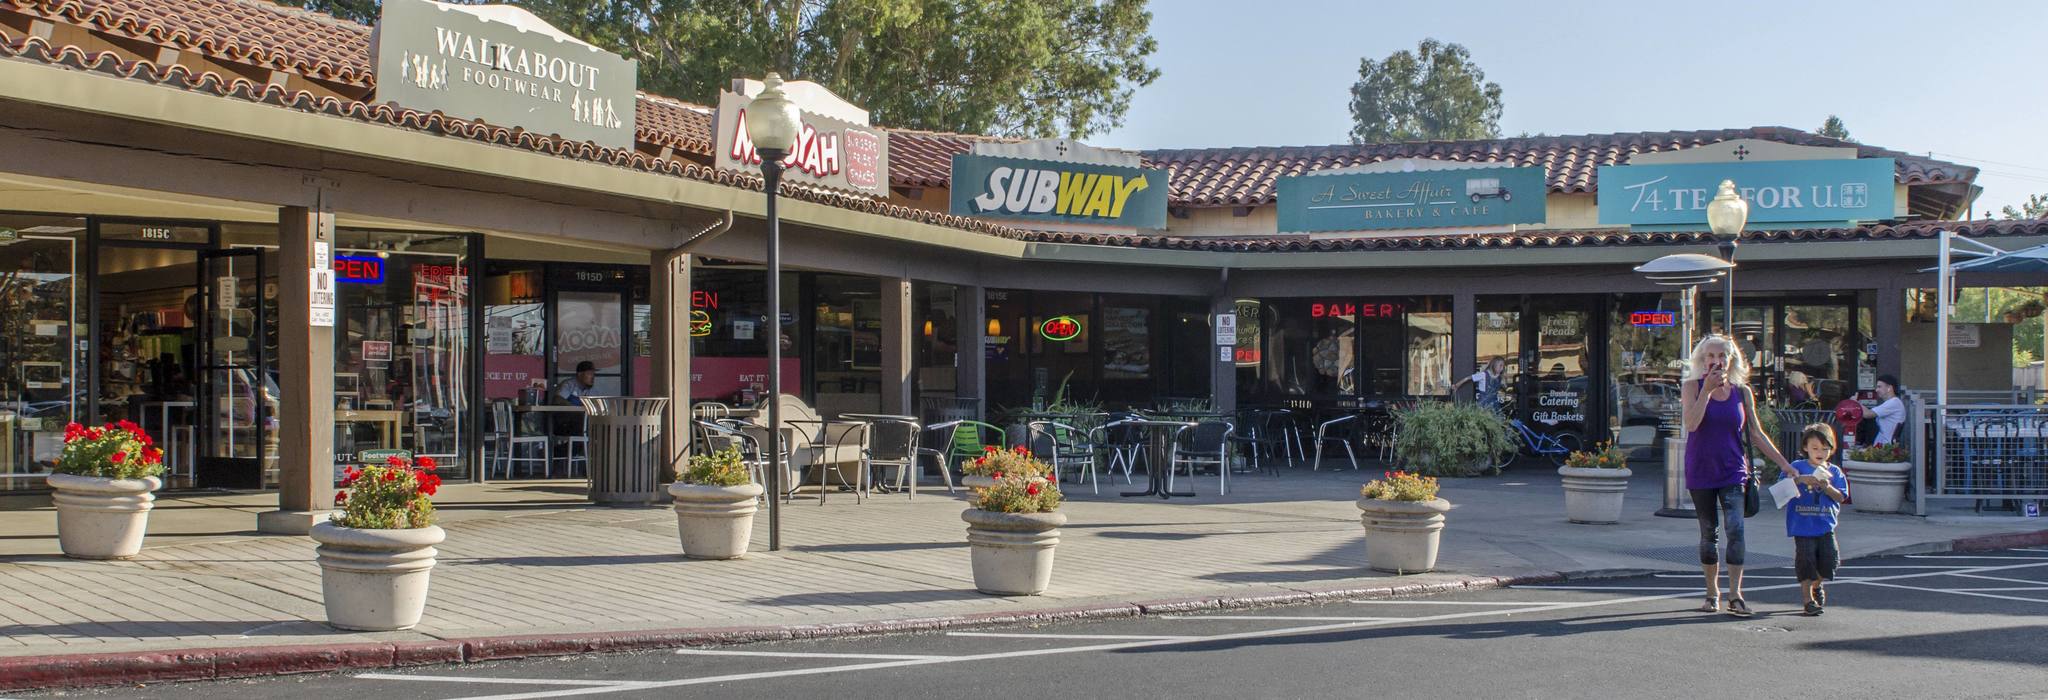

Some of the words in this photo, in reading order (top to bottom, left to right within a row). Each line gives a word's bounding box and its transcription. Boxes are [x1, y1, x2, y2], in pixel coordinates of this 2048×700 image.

[435, 26, 600, 93] WALKABOUT
[463, 67, 563, 103] FOOTWEAR
[975, 166, 1149, 218] SUBWAY
[1311, 184, 1335, 203] A
[1340, 184, 1393, 202] Sweet
[1397, 179, 1453, 204] Affair
[1668, 188, 1708, 210] TE
[1741, 186, 1804, 209] FOR
[1364, 208, 1424, 220] BAKERY
[1432, 208, 1442, 217] &
[1451, 206, 1490, 217] CAFE
[142, 228, 170, 241] 1815C
[335, 260, 380, 281] PEN
[576, 272, 603, 282] 1815D
[317, 272, 328, 290] NO
[311, 292, 334, 305] LOITERING
[1221, 316, 1231, 326] NO
[1547, 315, 1575, 327] Fresh
[1632, 313, 1673, 325] OPEN
[1046, 321, 1076, 337] OPEN
[1541, 326, 1577, 336] Breads
[516, 372, 528, 381] UP
[740, 374, 754, 382] EAT
[756, 374, 766, 382] IT
[1539, 395, 1579, 408] Catering
[1533, 411, 1549, 422] Gift
[1551, 411, 1585, 422] Baskets
